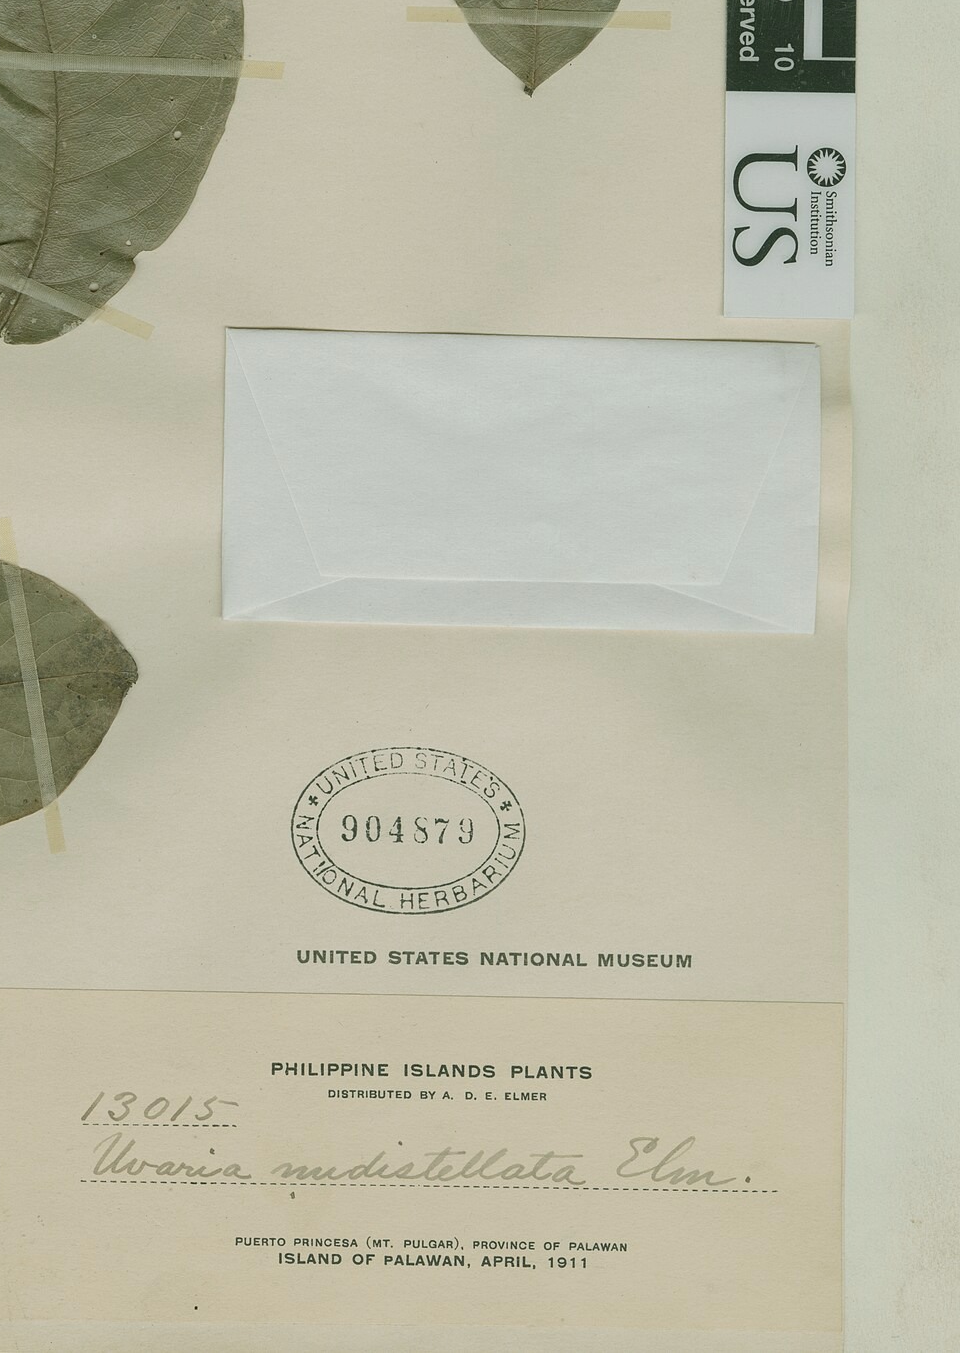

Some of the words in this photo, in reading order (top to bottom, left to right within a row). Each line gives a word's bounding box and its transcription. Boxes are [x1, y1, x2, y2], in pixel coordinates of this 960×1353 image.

[774, 43, 795, 72] 10
[732, 145, 799, 267] US
[810, 191, 822, 255] Institution
[825, 191, 838, 267] Smithsonian
[315, 752, 404, 796] UNITED
[414, 752, 501, 799] STATES
[341, 814, 475, 845] 904879
[296, 814, 386, 908] NATIONAL
[400, 822, 521, 910] HERBARIUM
[296, 949, 378, 965] UNITED
[388, 950, 469, 966] STATES
[480, 951, 588, 967] NATIONAL
[597, 953, 693, 968] MUSEUM
[271, 1062, 390, 1077] PHILIPPINE
[404, 1064, 496, 1079] ISLANDS
[511, 1065, 593, 1080] PLANTS
[81, 1091, 239, 1121] 13015
[328, 1089, 412, 1099] DISTRIBUTED
[420, 1090, 437, 1100] BY
[443, 1091, 454, 1100] A.
[465, 1091, 478, 1101] D.
[485, 1091, 497, 1101] E.
[504, 1091, 548, 1101] ELMER
[93, 1132, 252, 1179] Uvaria
[235, 1236, 286, 1247] PUERTO
[293, 1237, 358, 1248] PRINCESA
[366, 1236, 394, 1250] (MT.
[403, 1237, 464, 1251] PULGAR),
[472, 1240, 536, 1250] PROVINCE
[543, 1241, 560, 1250] OF
[568, 1241, 628, 1252] PALAWAN
[278, 1252, 342, 1265] ISLAND
[352, 1253, 375, 1265] OF
[384, 1254, 471, 1269] PALAWAN,
[481, 1256, 537, 1270] APRIL,
[548, 1256, 588, 1268] 1911
